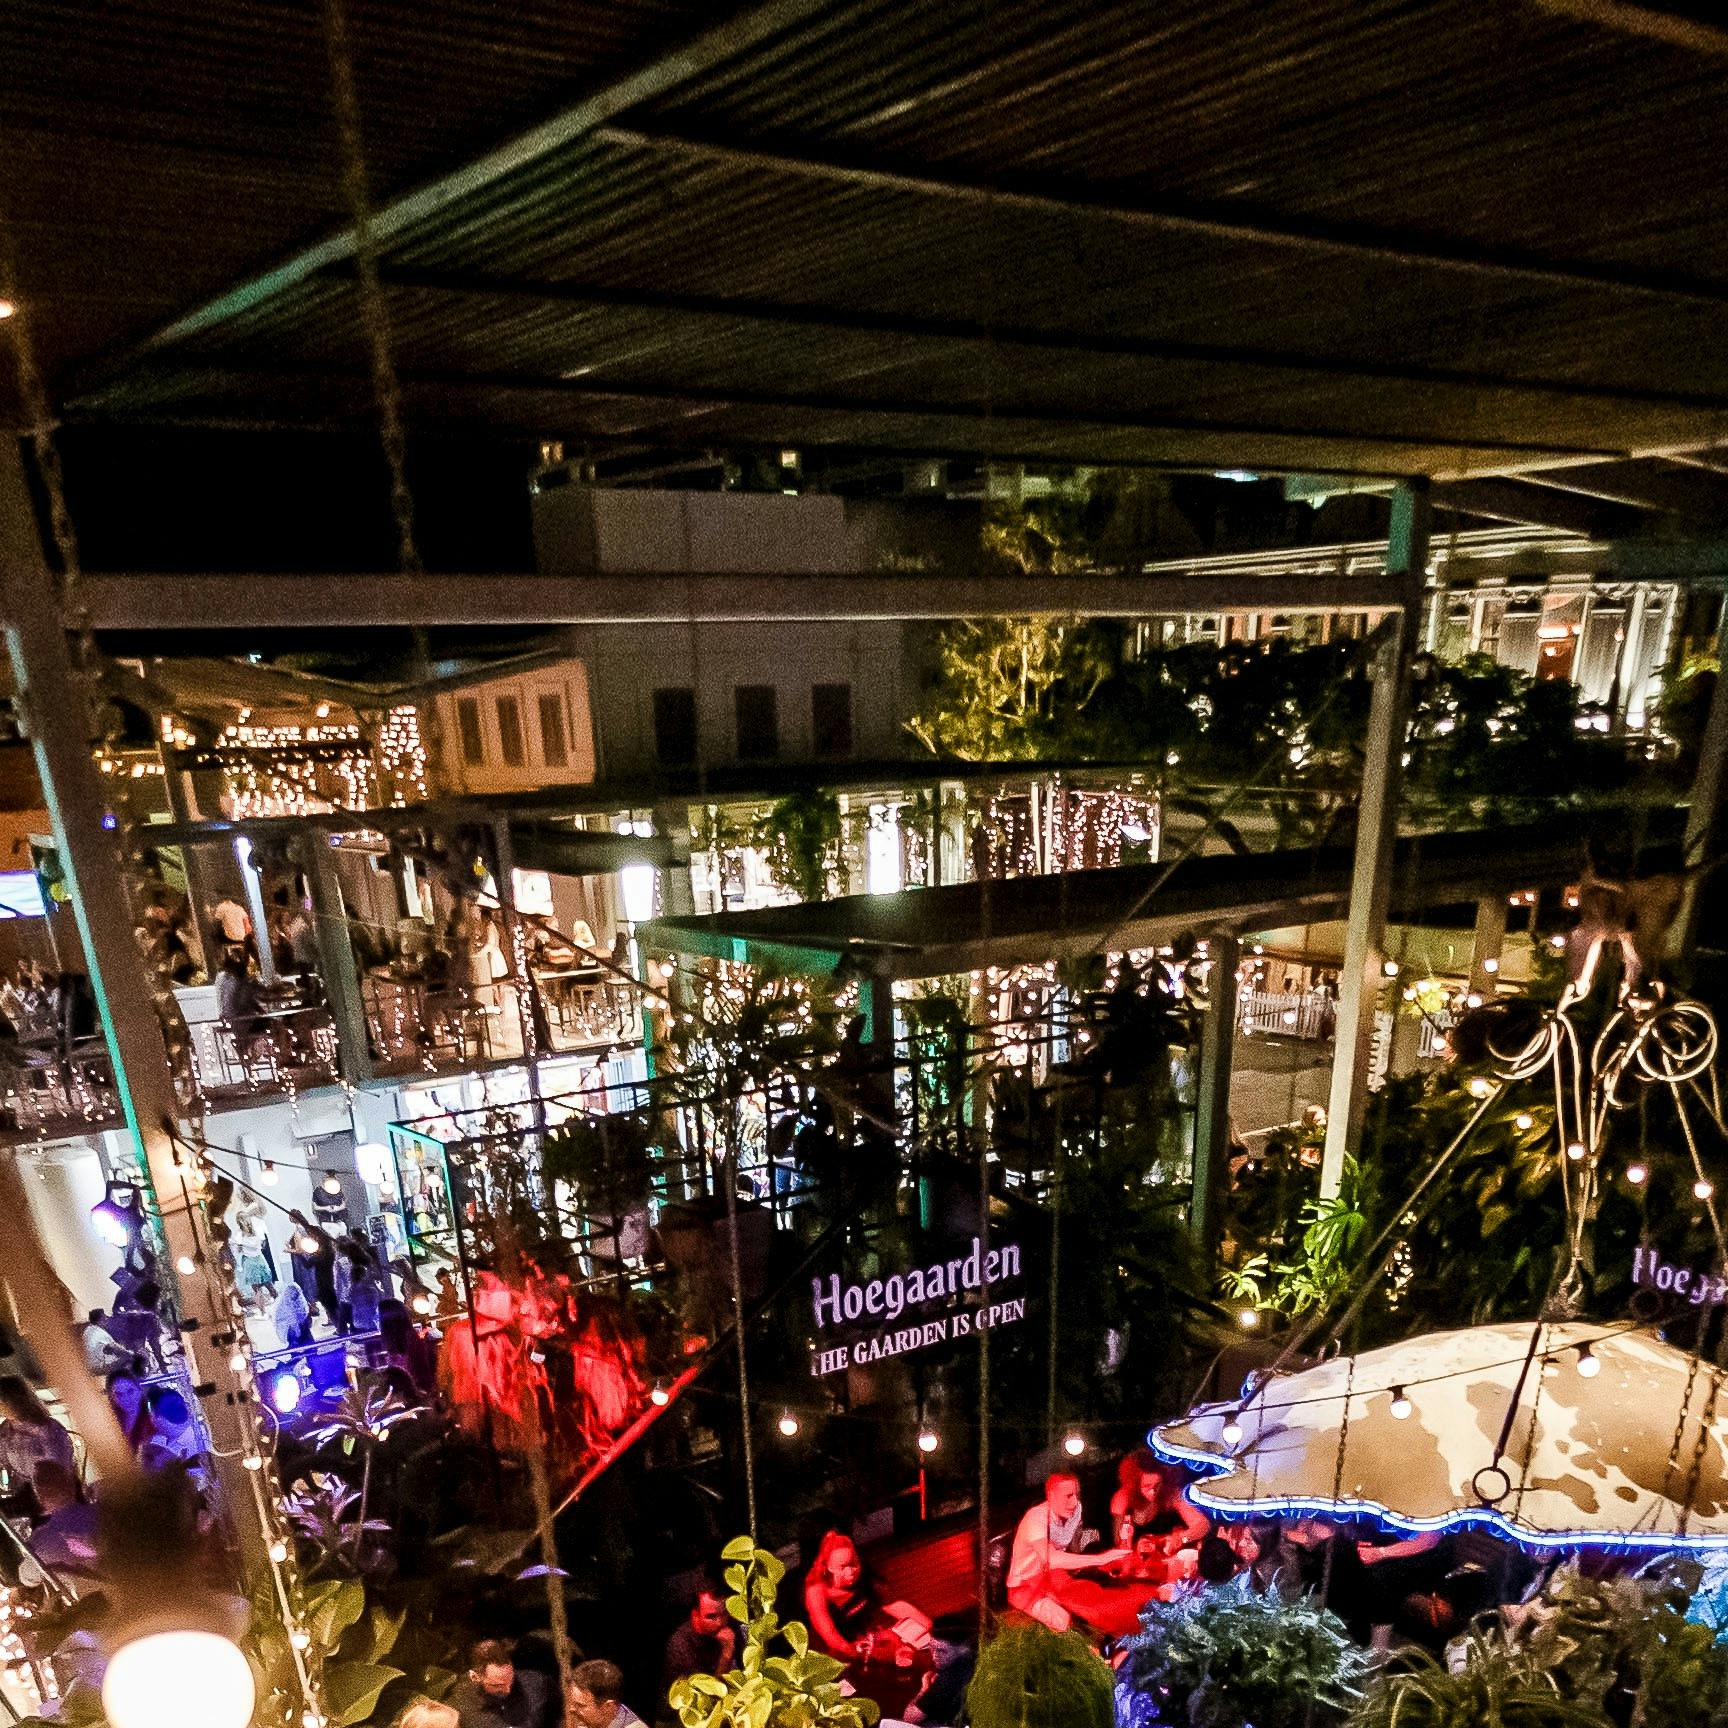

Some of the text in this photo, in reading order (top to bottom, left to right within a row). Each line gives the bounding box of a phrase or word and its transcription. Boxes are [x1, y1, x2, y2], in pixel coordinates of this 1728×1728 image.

[811, 1237, 1021, 1328] Hoegaarden
[853, 1319, 948, 1364] GAARDEN
[952, 1312, 970, 1338] IS
[975, 1298, 1025, 1330] OPEN
